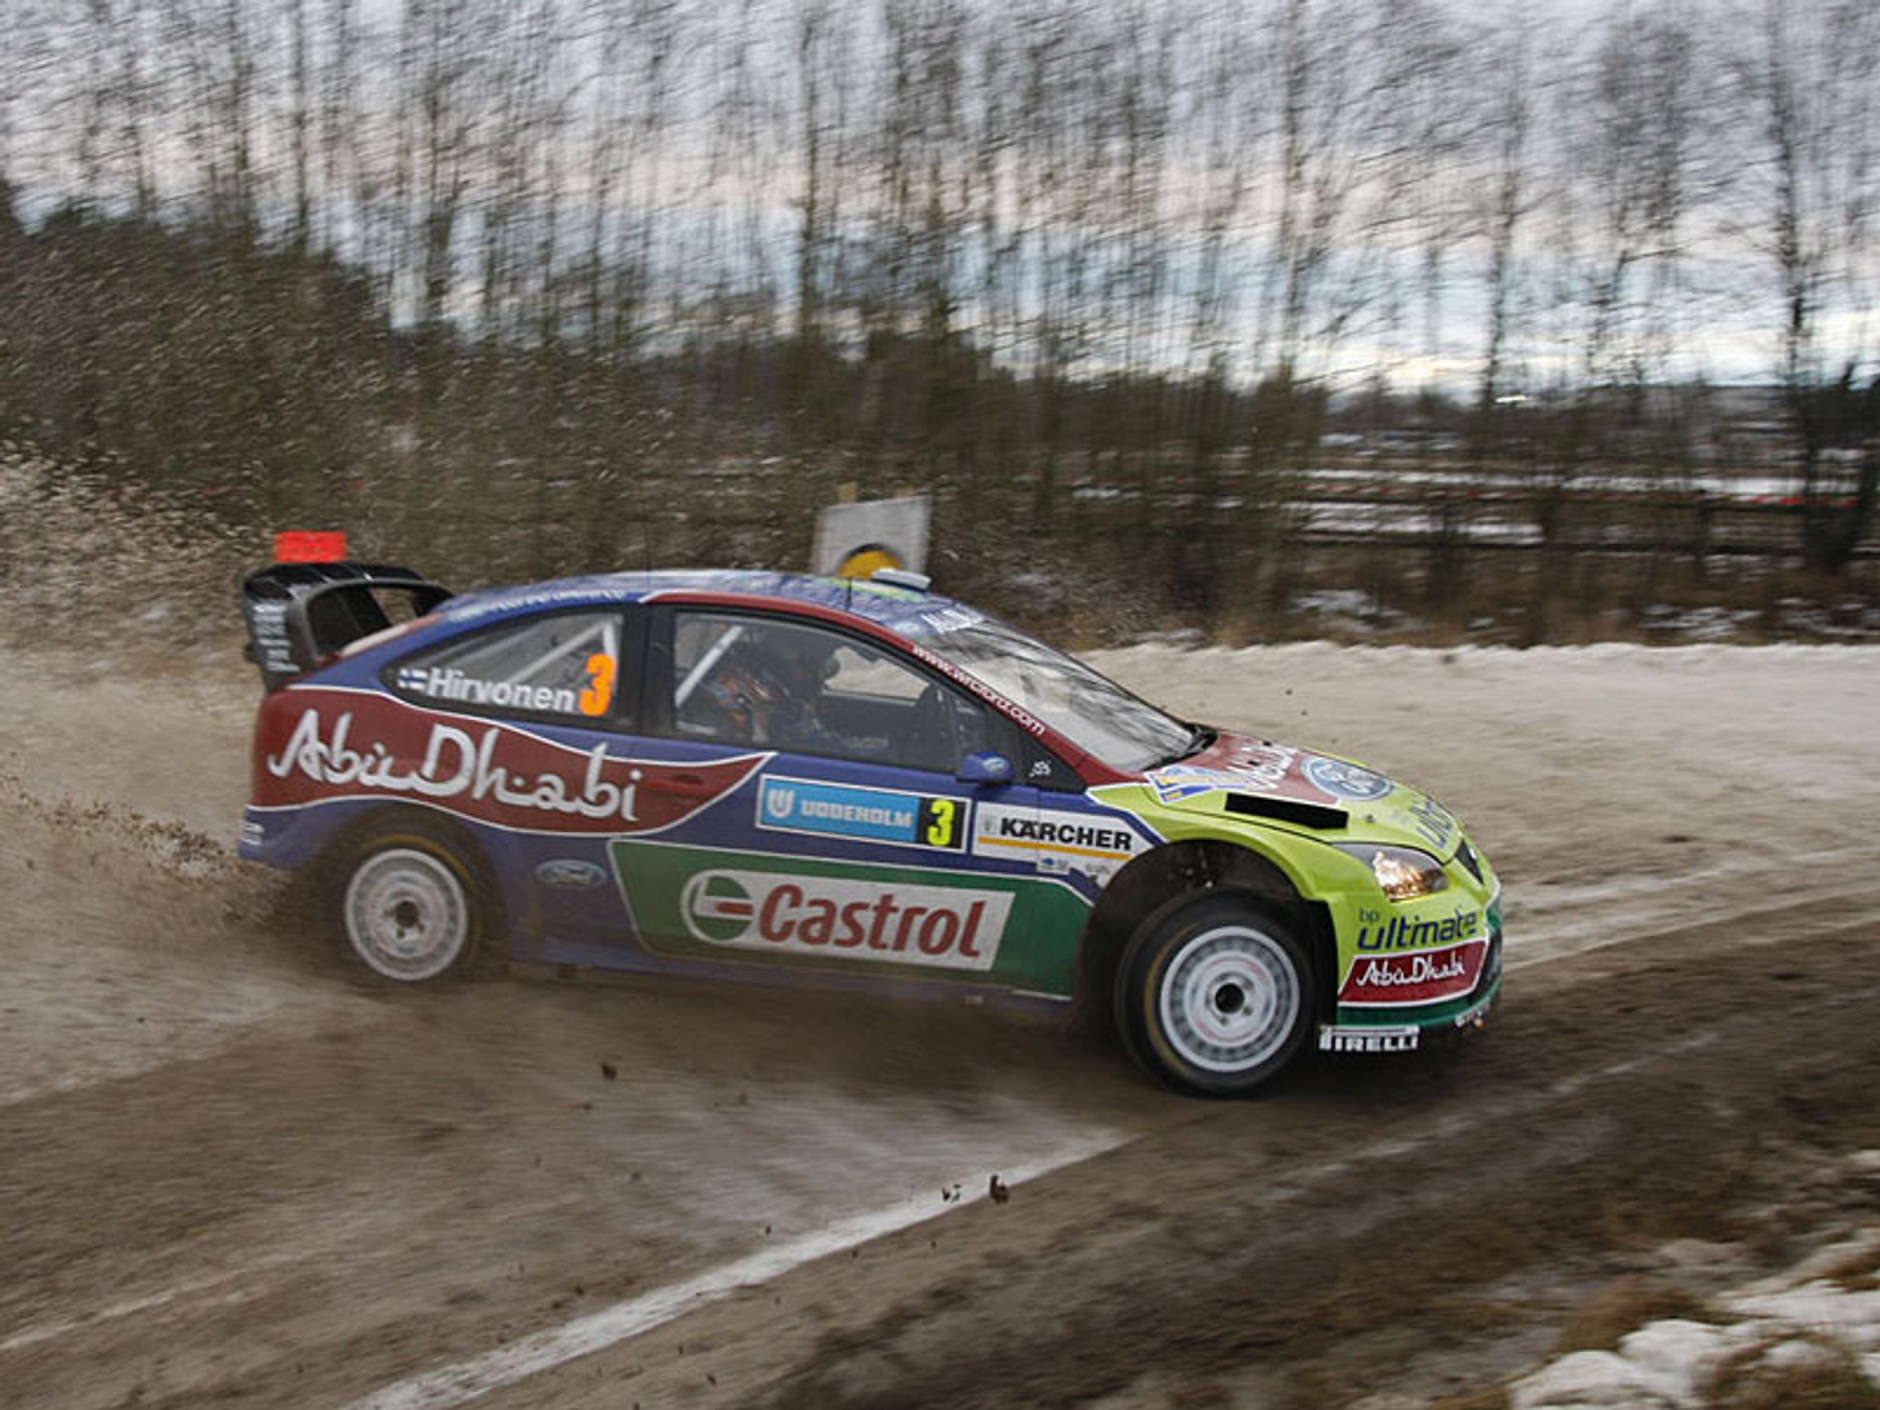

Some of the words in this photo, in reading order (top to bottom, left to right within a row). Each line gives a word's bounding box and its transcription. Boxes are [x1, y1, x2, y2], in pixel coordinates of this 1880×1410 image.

[426, 667, 577, 712] Hirvonen
[579, 653, 616, 716] 3
[268, 708, 402, 788] Abu
[402, 722, 643, 822] Dhabi
[927, 798, 955, 846] 3
[1000, 817, 1132, 850] KÄRCHER
[757, 883, 987, 958] Castrol
[1357, 905, 1478, 951] ultimate
[1358, 907, 1380, 923] bp
[1356, 959, 1408, 986] Abu
[1408, 951, 1466, 983] Dhabi
